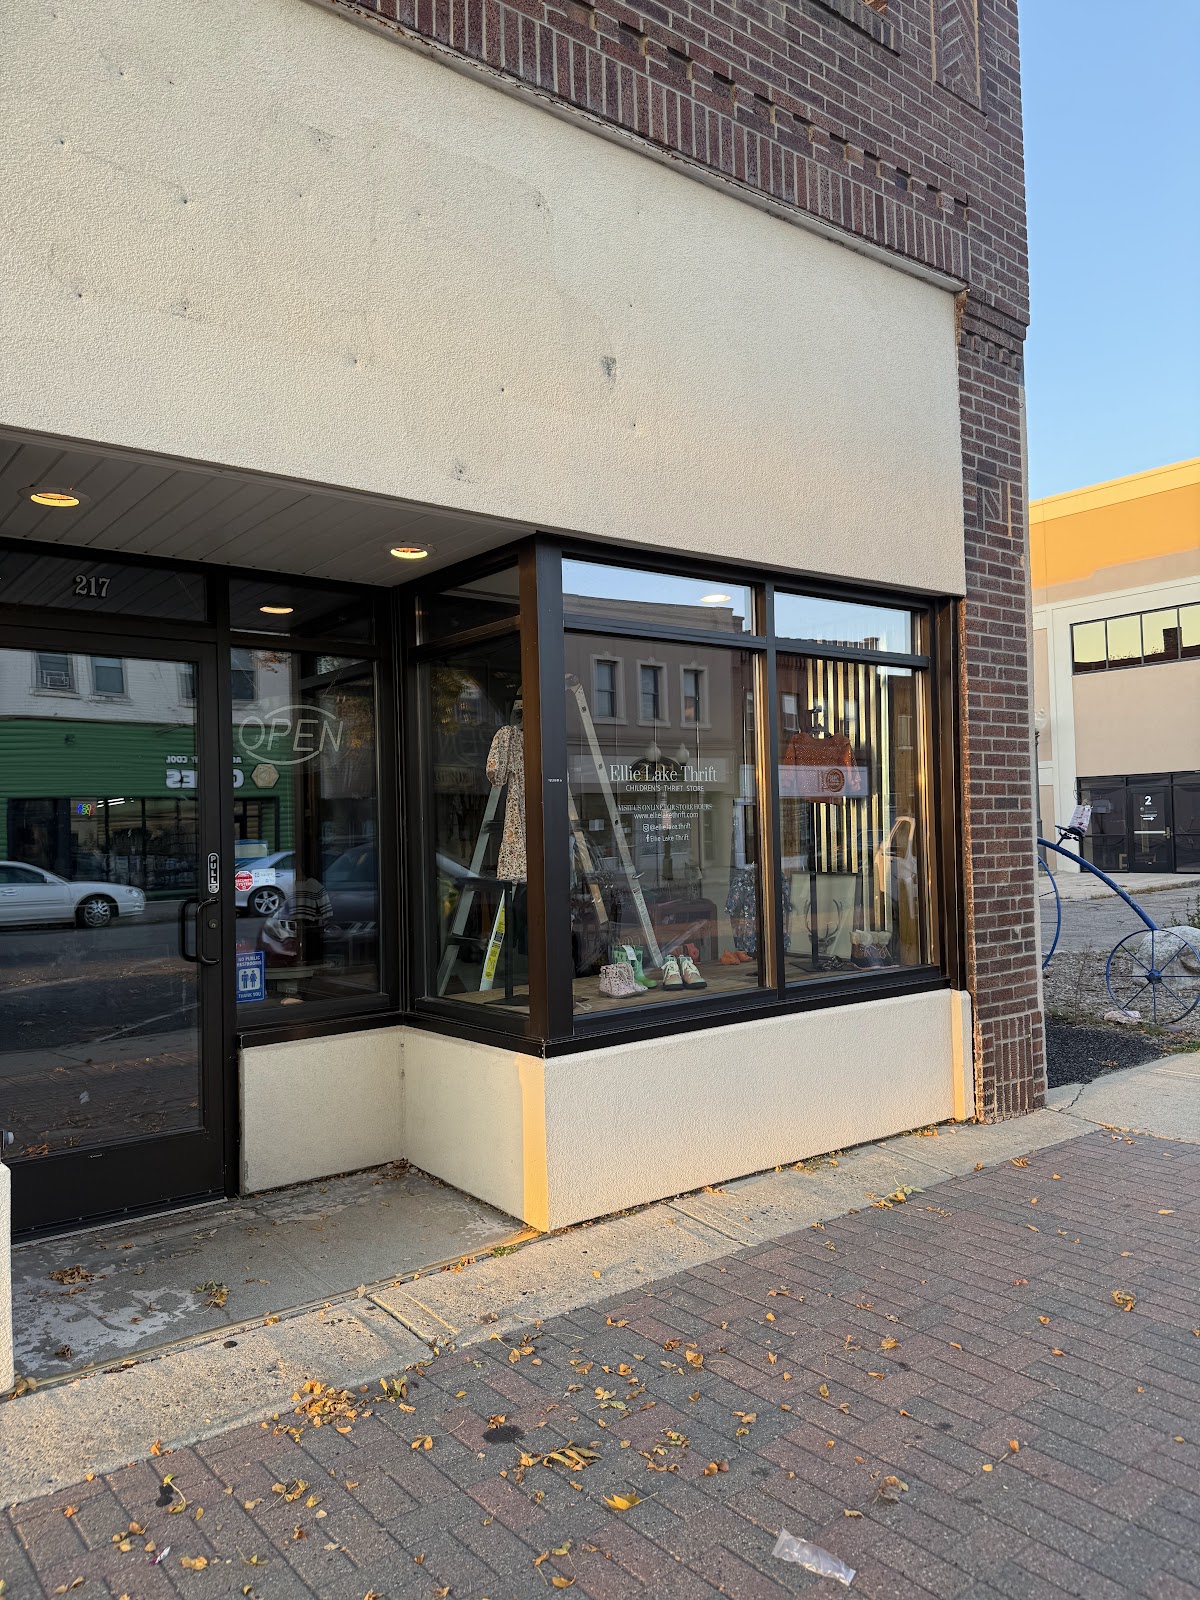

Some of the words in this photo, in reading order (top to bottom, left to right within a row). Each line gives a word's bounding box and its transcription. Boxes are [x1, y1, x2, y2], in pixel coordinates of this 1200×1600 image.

[75, 574, 111, 597] 217
[239, 715, 344, 752] OPEN
[610, 764, 640, 781] Ellie
[645, 764, 678, 782] Lake
[680, 765, 717, 782] Thrift
[625, 784, 661, 792] CHILDREN'S
[663, 784, 684, 792] THRIFT
[686, 784, 705, 792] STORE
[1144, 795, 1152, 805] 2
